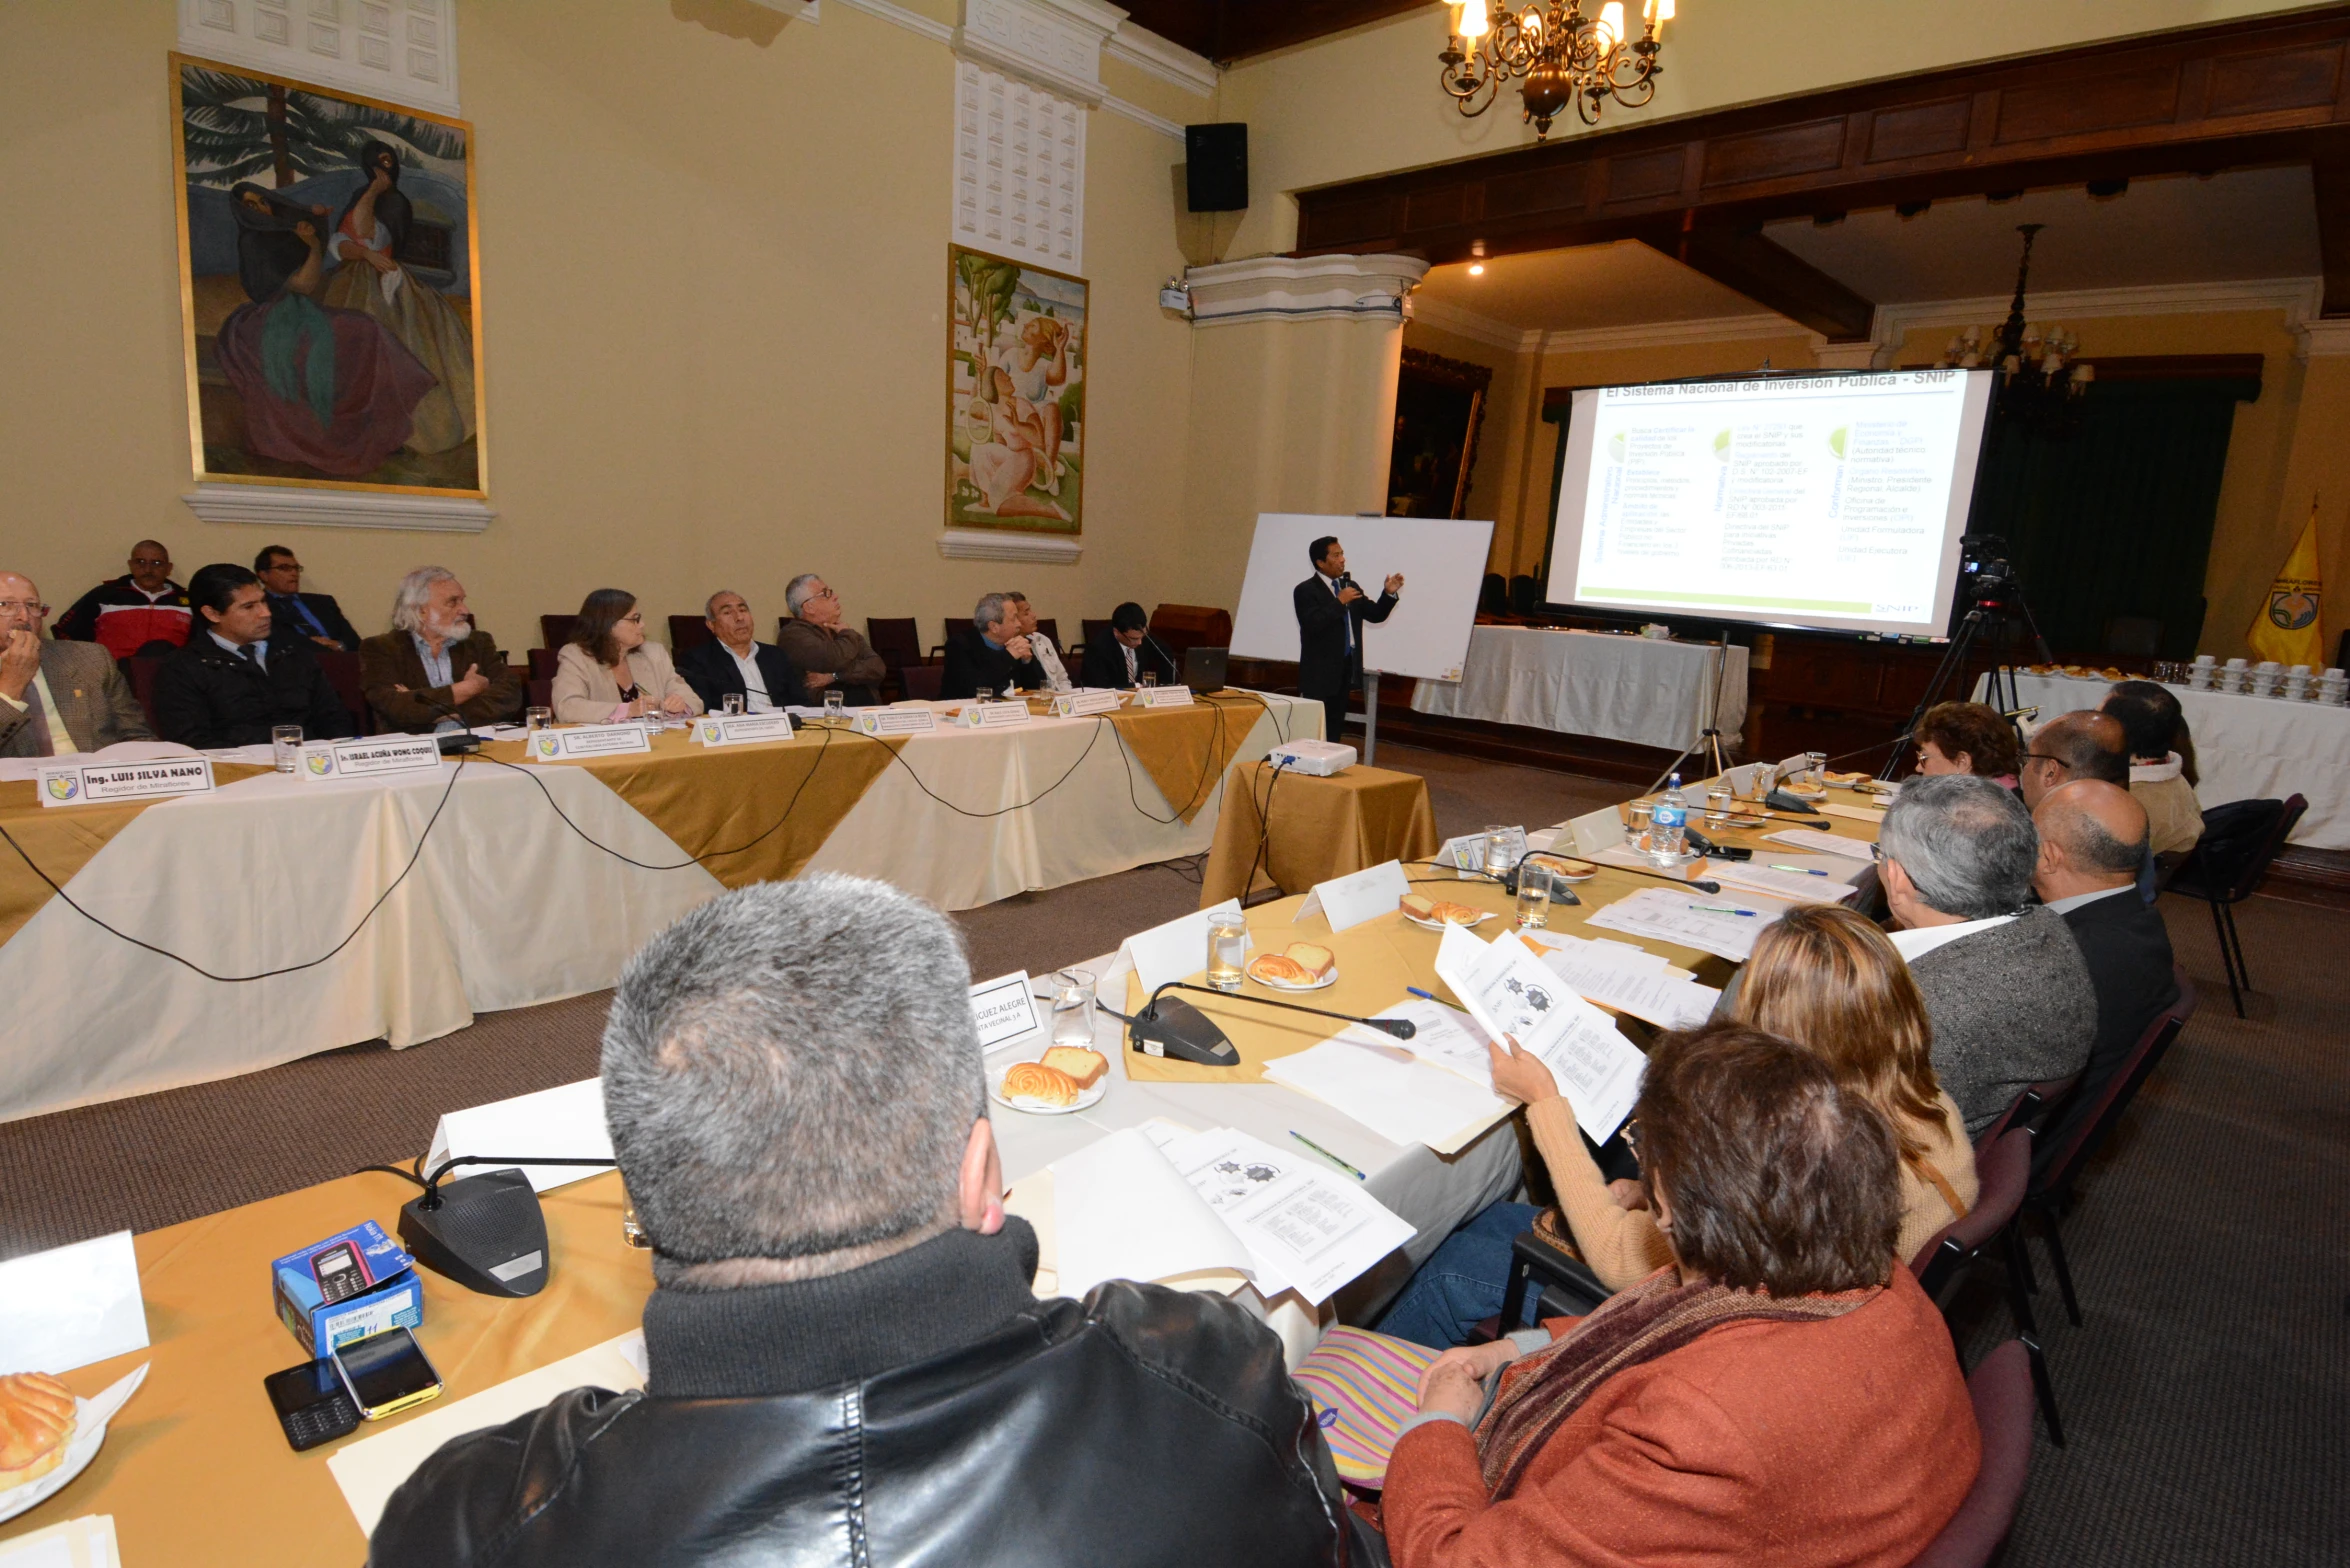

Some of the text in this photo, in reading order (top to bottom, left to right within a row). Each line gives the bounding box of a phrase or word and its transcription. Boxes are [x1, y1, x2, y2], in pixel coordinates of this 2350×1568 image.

[1606, 388, 1618, 398] El
[1623, 386, 1674, 397] Sistema
[1679, 382, 1738, 394] Nacional
[1743, 381, 1760, 392] de
[1914, 371, 1956, 384] SNIP
[1788, 424, 1803, 432] que
[1630, 443, 1661, 451] Proyectos
[1852, 448, 1894, 456] (Autoridad
[1754, 460, 1788, 468] aprobado
[1851, 456, 1894, 464] normativa)
[1886, 476, 1932, 484] Presidente
[1612, 467, 1622, 504] Nacional
[1714, 466, 1728, 512] Normativa
[1886, 485, 1922, 494] Alcalde)
[1828, 465, 1844, 518] Conforman
[1845, 496, 1873, 504] Oficina
[1844, 505, 1900, 514] Programación
[1595, 466, 1613, 564] Sistema Administrativo
[1843, 514, 1888, 522] Inversiones
[1872, 526, 1924, 534] Formuladora
[1868, 546, 1908, 555] Ejecutora
[2275, 578, 2322, 586] MIRAFLORES
[1876, 604, 1919, 613] SNIP
[350, 752, 370, 760] ISRAEL
[371, 748, 391, 759] ACUÑA
[392, 748, 411, 757] WONG
[354, 760, 380, 768] Regidor
[392, 756, 424, 764] Miraflores
[86, 766, 202, 785] Ing. LUIS SILVA NANO
[101, 784, 134, 794] Regidor
[150, 780, 190, 790] Miraflores
[976, 998, 1026, 1020] IGUEZ ALEGRE
[978, 1023, 988, 1032] NTA
[988, 1016, 1012, 1028] VECINAL
[364, 1222, 378, 1236] Nokia
